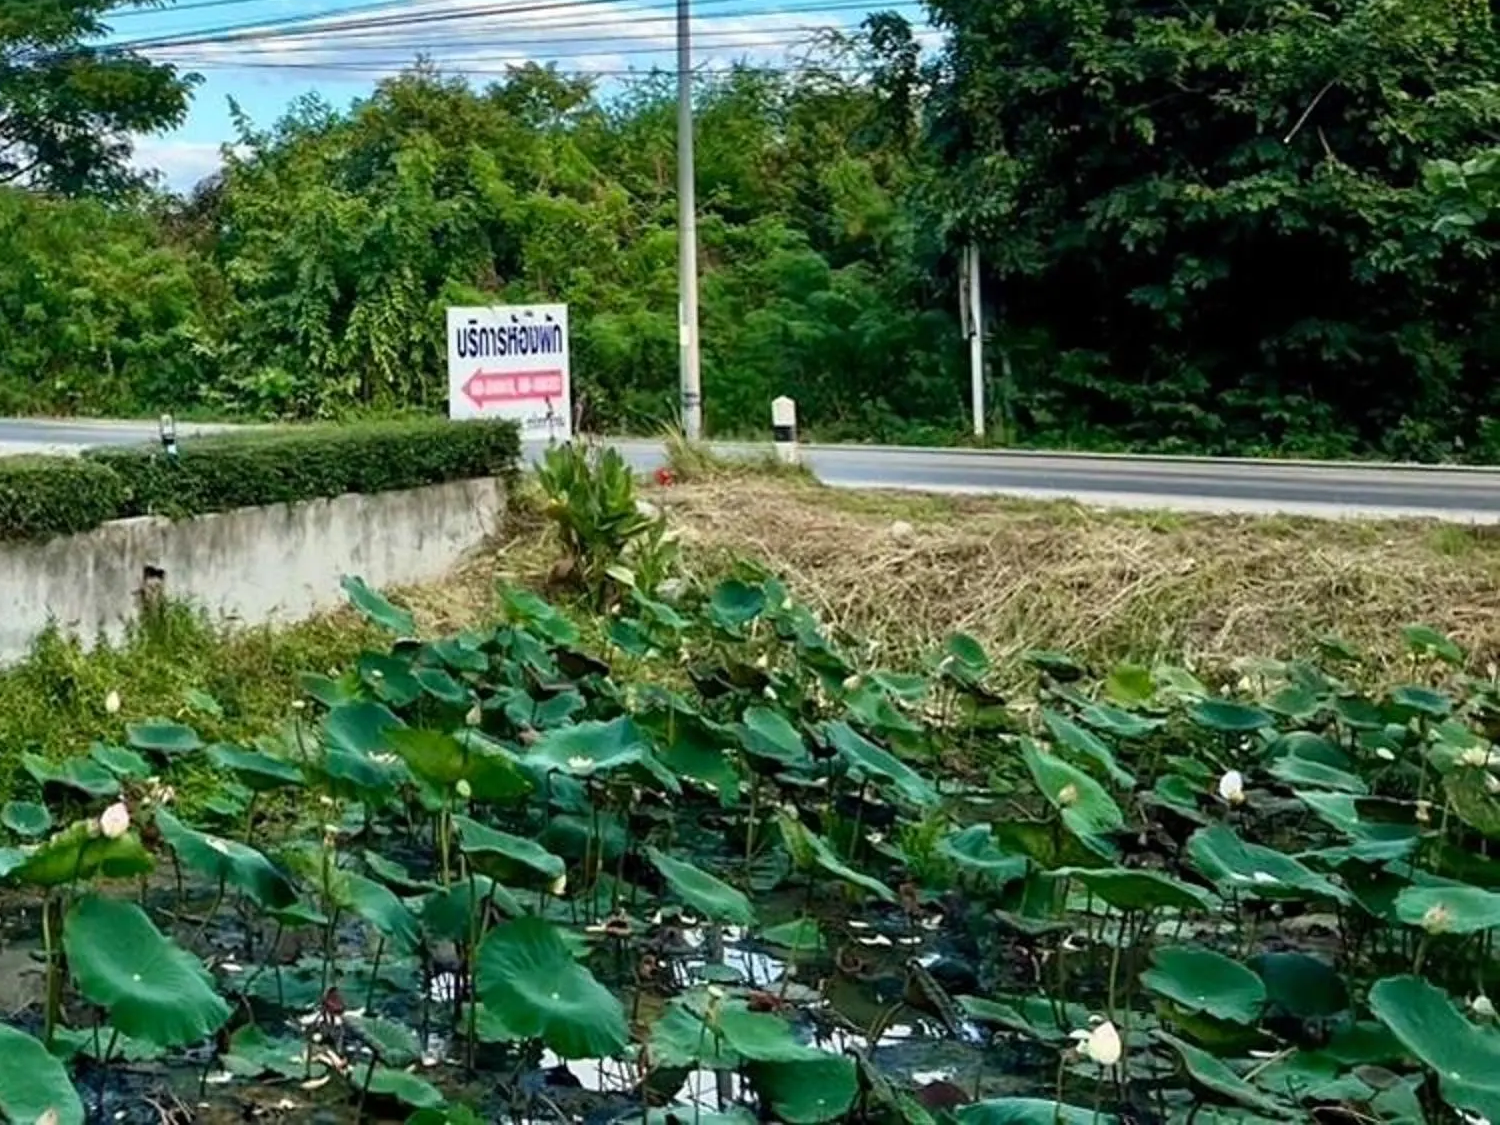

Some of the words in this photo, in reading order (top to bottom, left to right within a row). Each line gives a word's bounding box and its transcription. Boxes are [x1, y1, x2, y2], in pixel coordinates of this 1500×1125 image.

[457, 313, 563, 358] บริการห้องพัก
